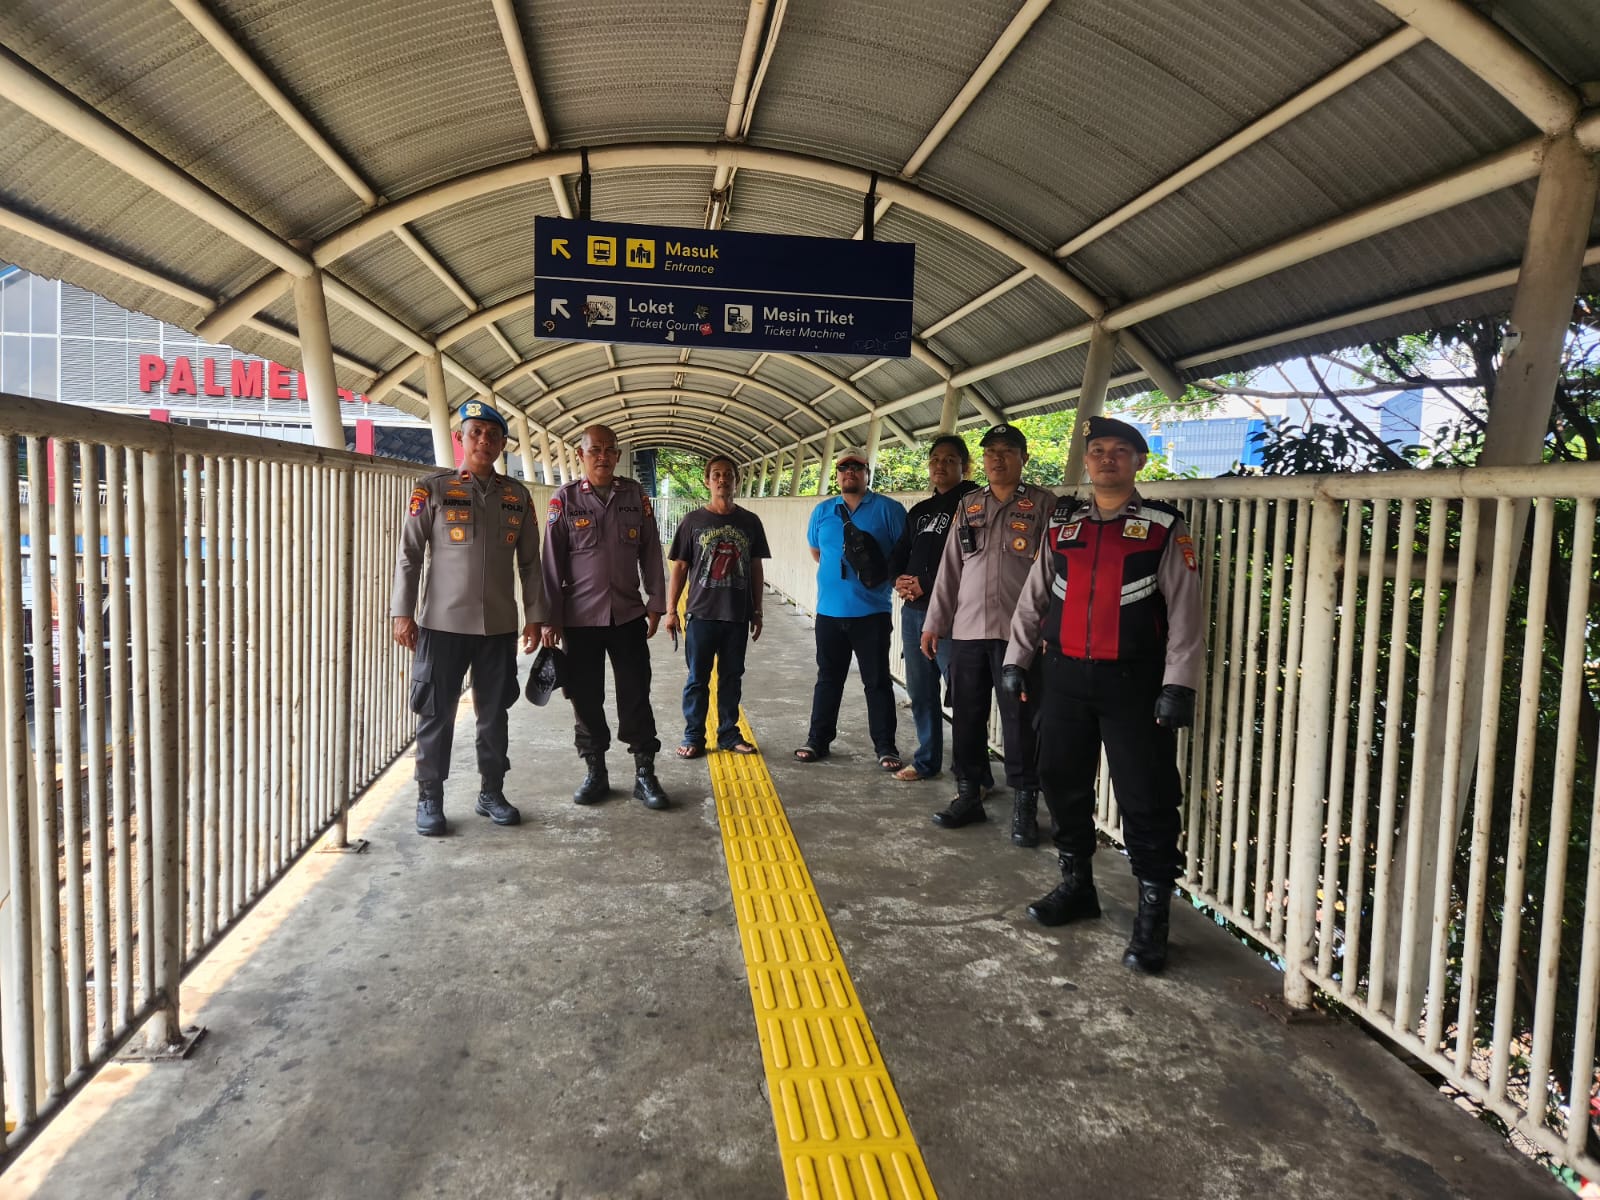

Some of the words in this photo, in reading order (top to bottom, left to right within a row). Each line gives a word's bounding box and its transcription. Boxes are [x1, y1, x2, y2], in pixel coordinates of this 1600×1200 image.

[665, 241, 719, 259] Masuk
[664, 260, 715, 274] Entrance
[628, 298, 675, 315] Loket
[763, 306, 810, 323] Mesin
[814, 309, 855, 325] Tiket
[630, 317, 663, 329] Ticket
[666, 319, 705, 332] Count
[764, 325, 796, 337] Ticket
[799, 327, 846, 340] Machine
[139, 354, 372, 404] PALME
[1010, 511, 1036, 520] POLRI
